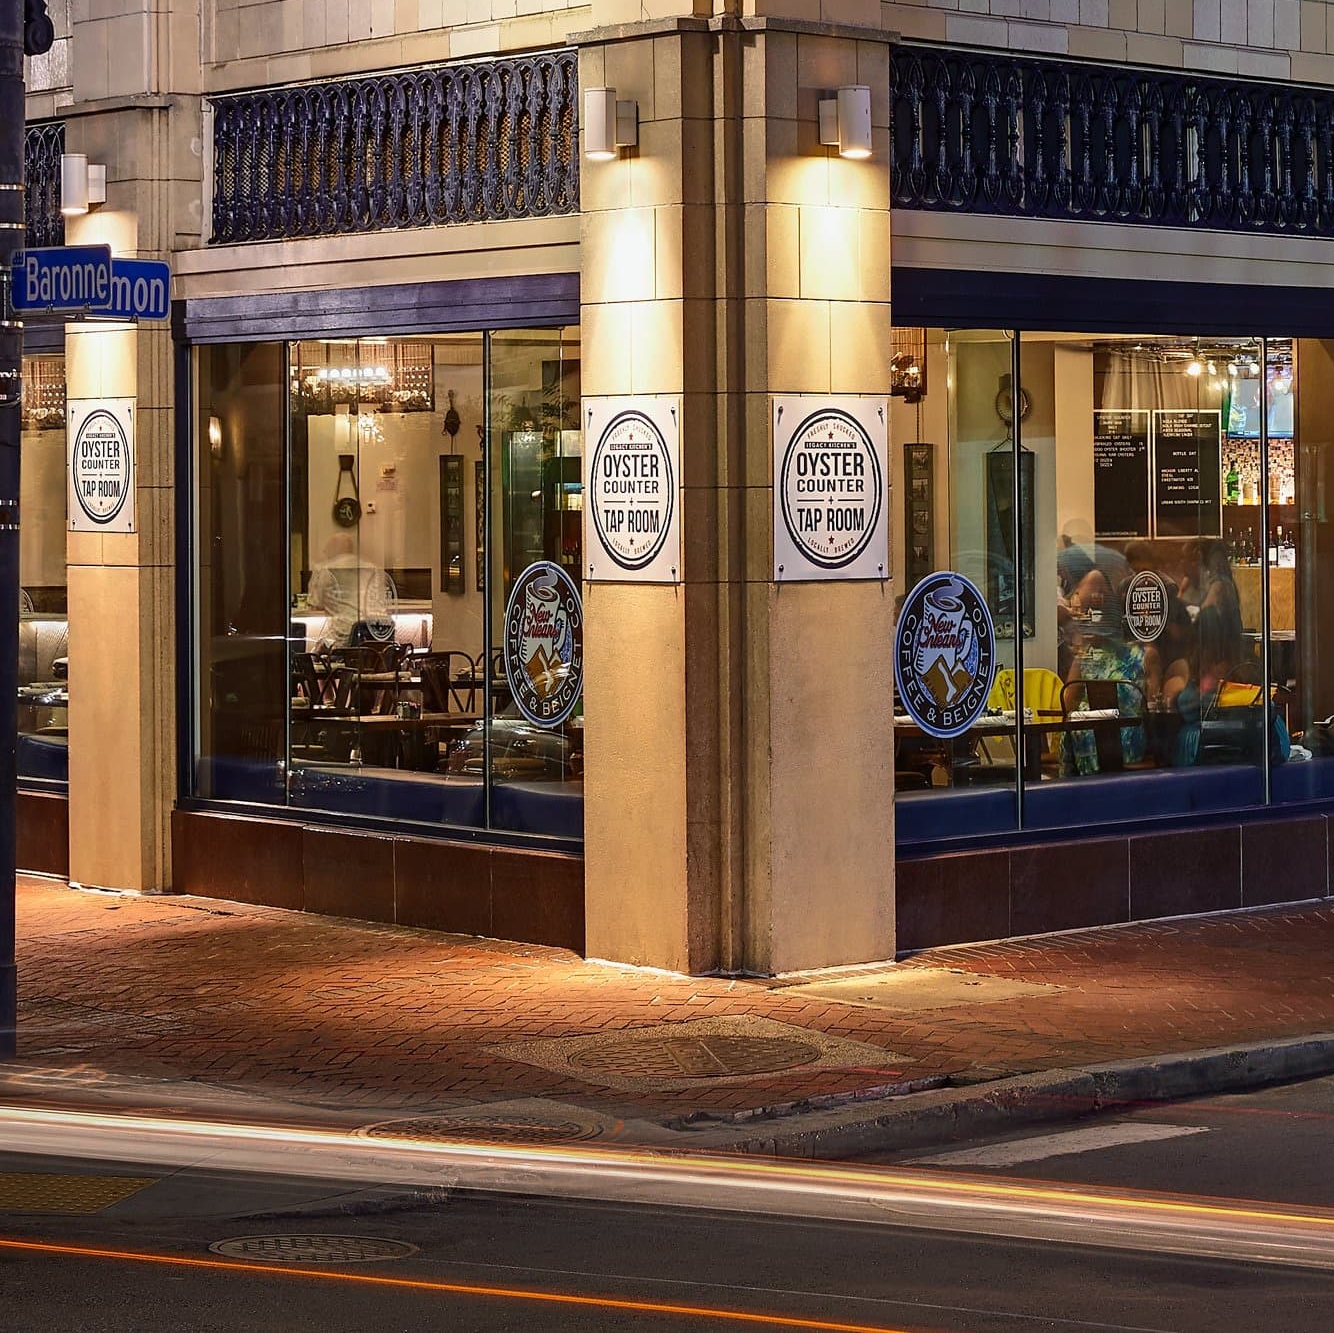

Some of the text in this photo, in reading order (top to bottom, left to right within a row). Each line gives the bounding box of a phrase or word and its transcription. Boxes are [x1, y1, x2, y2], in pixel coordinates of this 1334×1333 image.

[26, 256, 109, 302] Baronne
[81, 440, 120, 458] OYSTER
[82, 459, 120, 469] COUNTER
[603, 454, 659, 478] OYSTER
[796, 452, 864, 477] OYSTER
[82, 480, 120, 497] TAP ROOM
[603, 480, 659, 494] COUNTER
[797, 479, 864, 493] COUNTER
[604, 509, 659, 533] TAP ROOM
[797, 508, 864, 532] TAP ROOM
[1132, 590, 1161, 603] OYSTER
[530, 604, 554, 621] New
[928, 615, 957, 633] New
[509, 604, 529, 699] COFFEE
[529, 698, 537, 712] &
[543, 638, 582, 716] BEIGNET
[901, 614, 925, 710] COFFEE
[927, 709, 937, 723] &
[943, 647, 989, 726] BEIGNET
